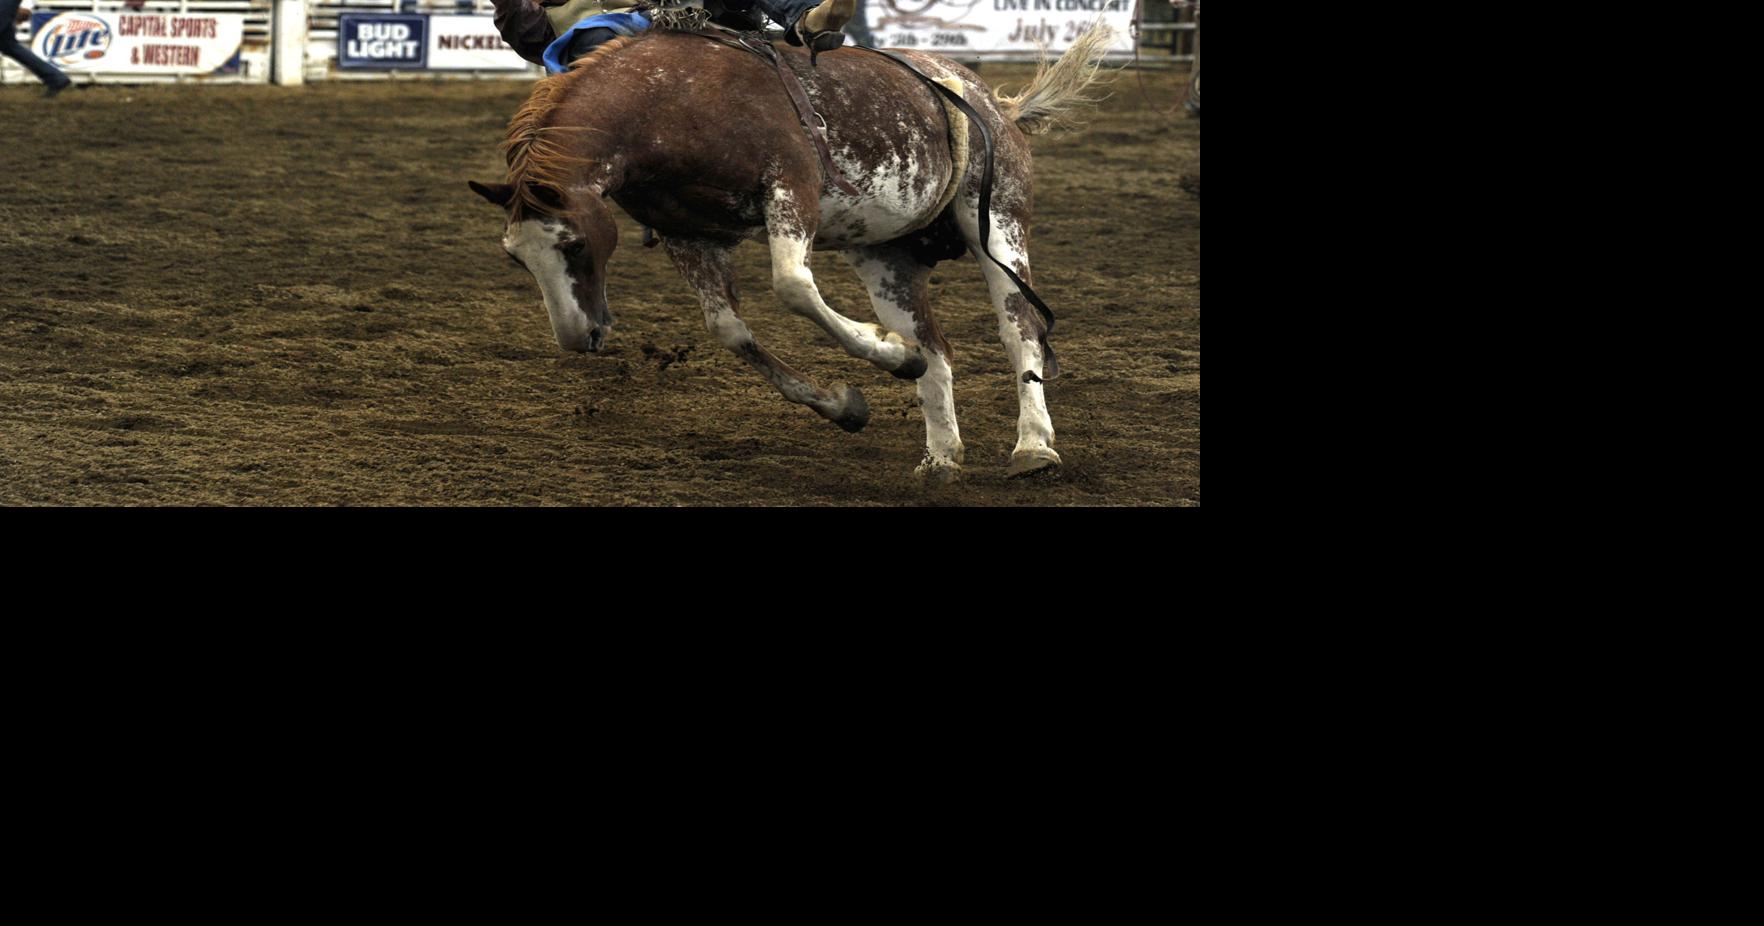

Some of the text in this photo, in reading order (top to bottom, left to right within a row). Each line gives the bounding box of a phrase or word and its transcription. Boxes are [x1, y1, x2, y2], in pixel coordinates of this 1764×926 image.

[118, 15, 218, 38] CAPITAL SPORTS
[357, 23, 411, 40] BUD
[1007, 17, 1060, 46] July
[49, 29, 109, 58] Lite
[346, 40, 419, 59] LIGHT
[437, 34, 513, 51] NICKEL
[130, 44, 202, 67] & WESTERN
